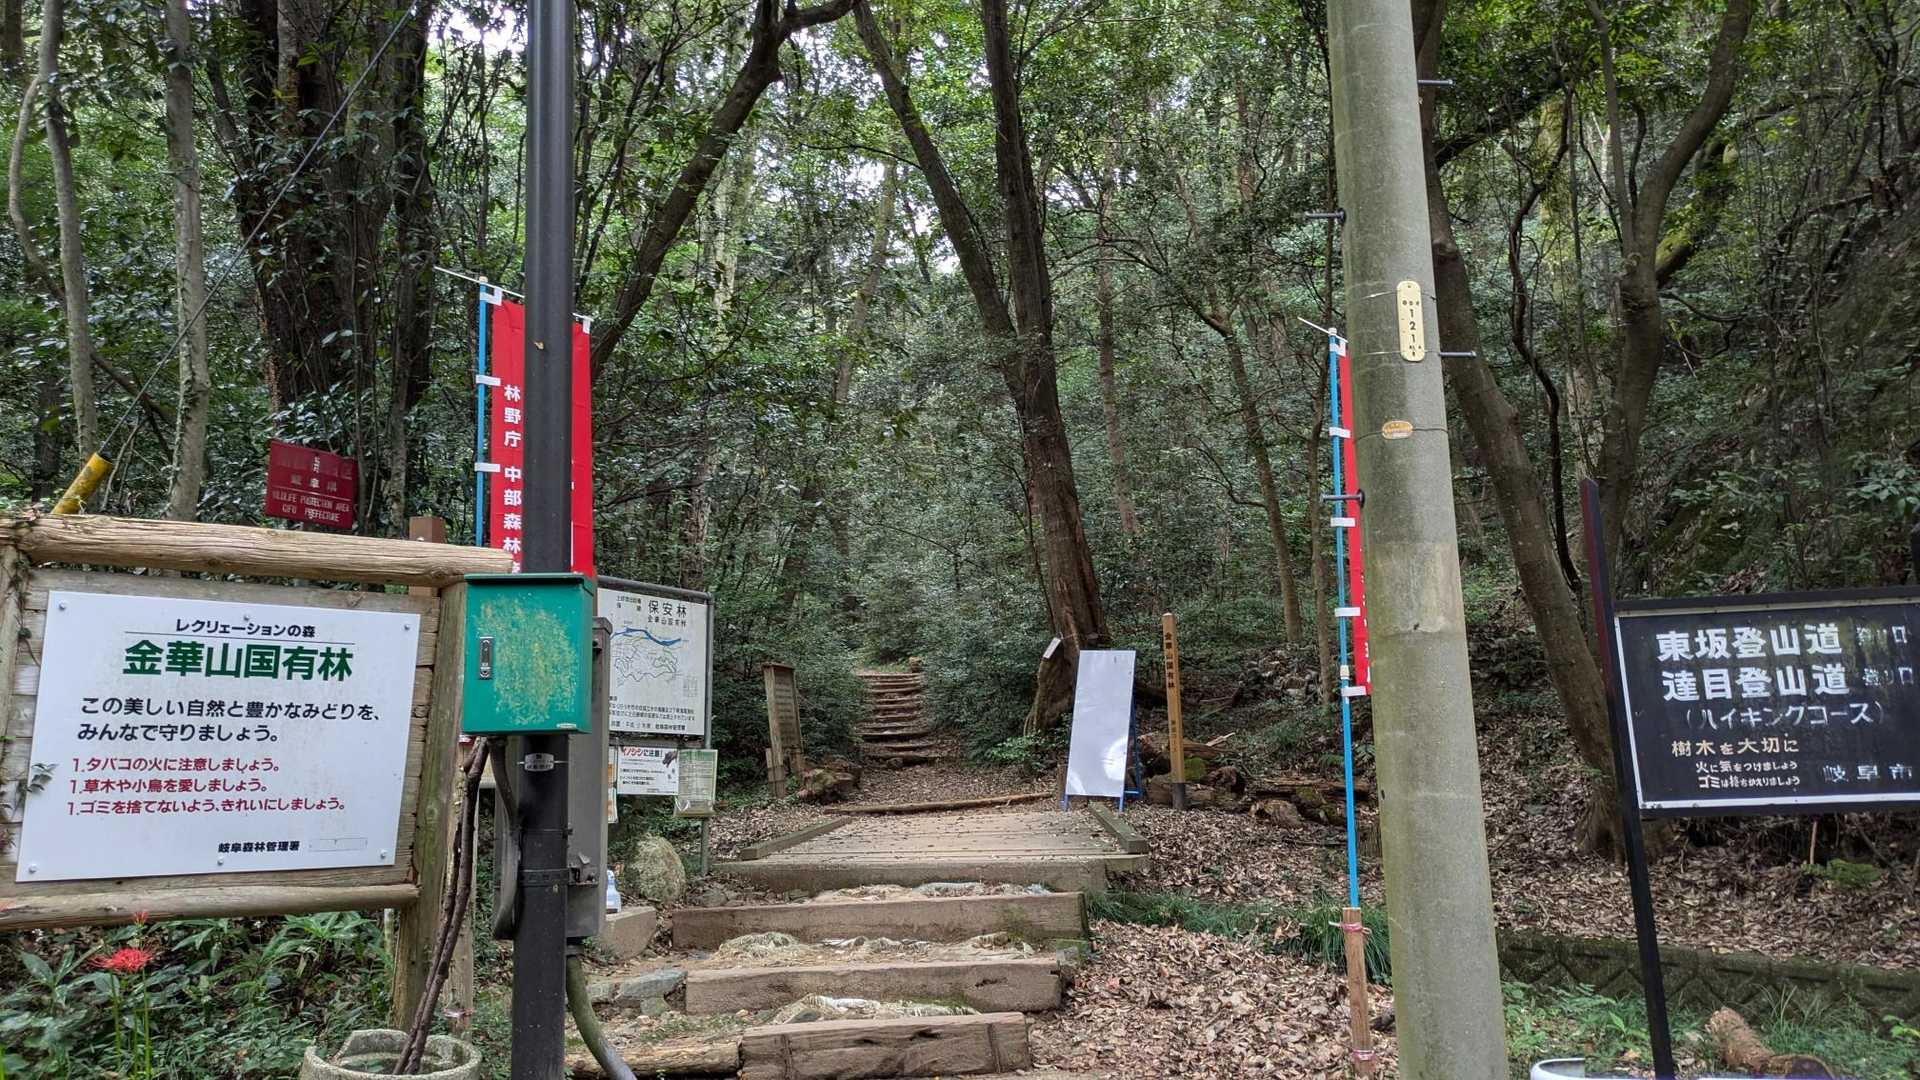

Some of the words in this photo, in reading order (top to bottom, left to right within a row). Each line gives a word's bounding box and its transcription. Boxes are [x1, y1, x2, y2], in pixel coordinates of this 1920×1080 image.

[503, 384, 521, 448] 林野庁
[648, 600, 687, 618] 保安林
[1655, 622, 1842, 661] 東坂登山道
[123, 639, 354, 682] 金華山国有林
[1662, 663, 1850, 701] 達目登山道
[81, 697, 381, 721] この美しい自然と豊かなみどりを、
[1686, 701, 1883, 730] （ハイキングコース）
[77, 722, 280, 742] みんなで守りましょう。
[1671, 737, 1800, 757] 樹木を大切に
[1695, 760, 1798, 774] 火に気をつけましょう
[218, 841, 300, 853] 岐阜森林管理署
